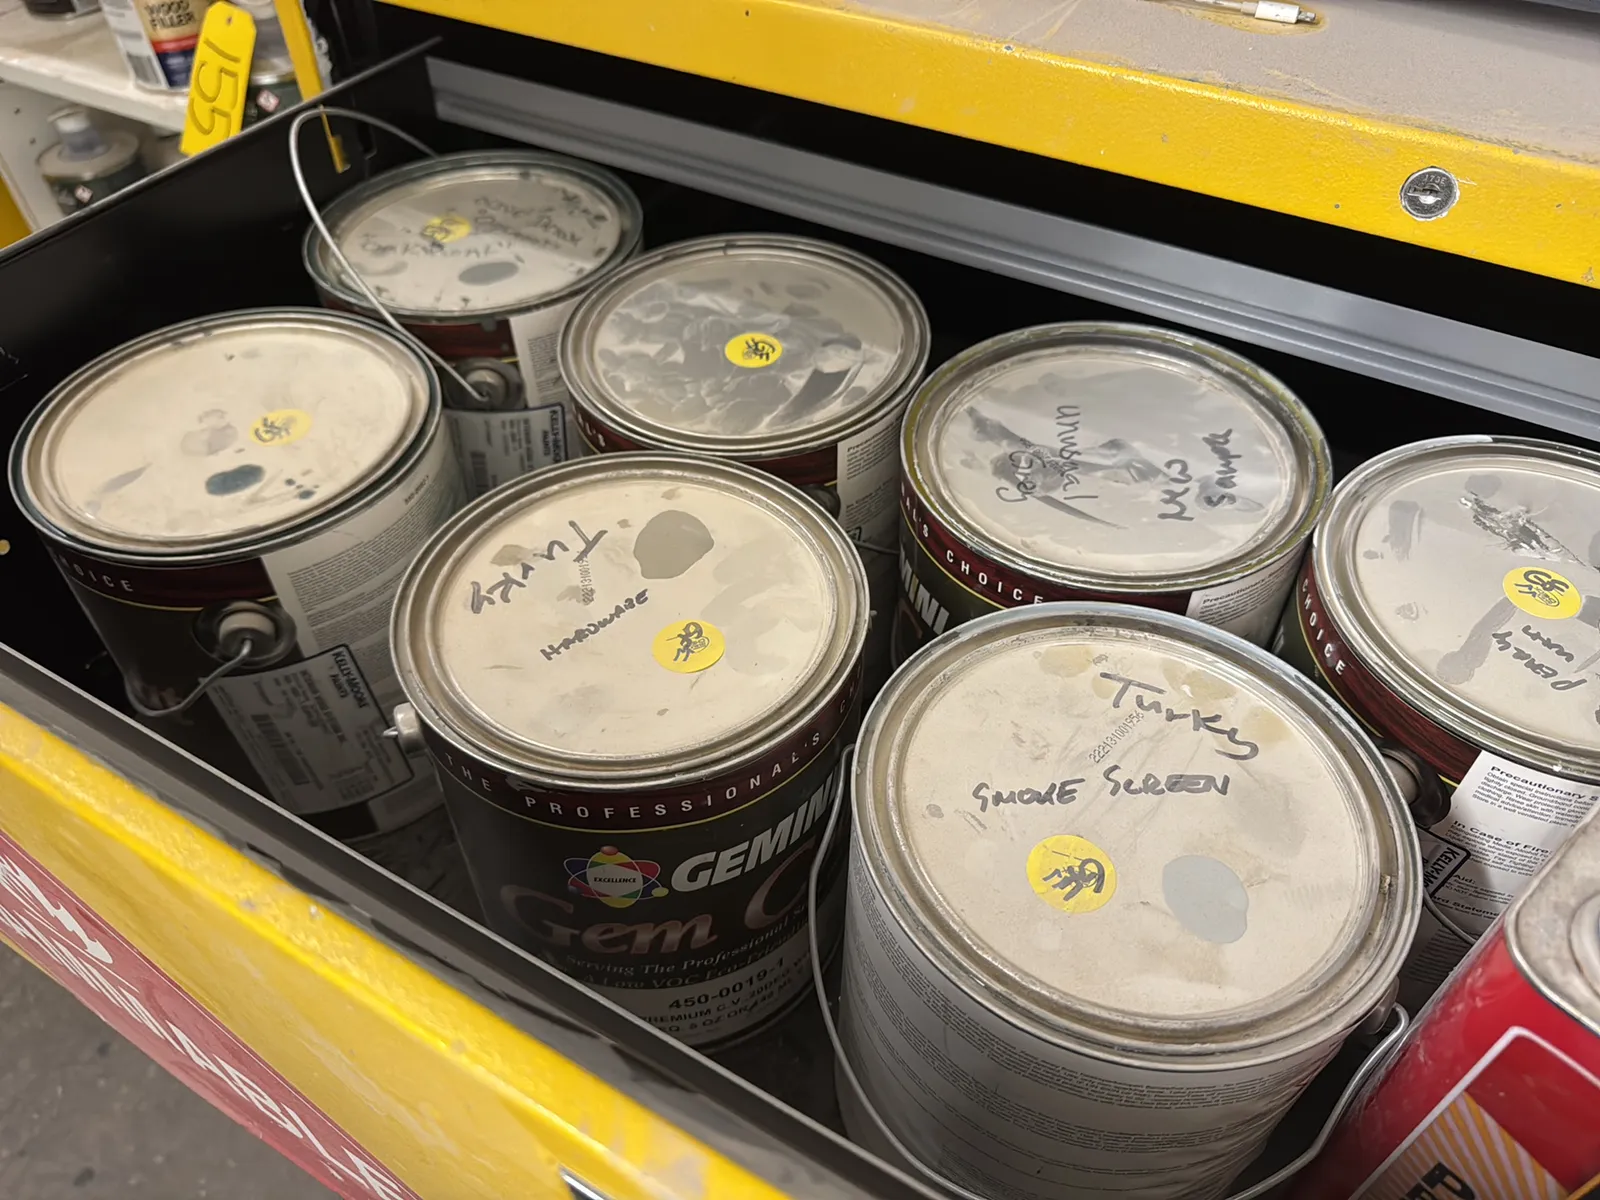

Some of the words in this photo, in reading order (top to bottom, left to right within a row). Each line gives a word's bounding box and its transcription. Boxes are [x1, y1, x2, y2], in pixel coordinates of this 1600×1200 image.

[151, 11, 195, 29] FILLER
[189, 38, 241, 139] 155
[995, 451, 1046, 502] Grey
[1055, 404, 1099, 500] unusual
[946, 550, 1044, 605] CHOICE
[1301, 578, 1346, 676] CHOICE
[444, 752, 493, 792] THE
[525, 731, 822, 820] PROFESSIONAL'S
[1103, 764, 1230, 797] SCREEN
[1491, 766, 1586, 799] Precautionary
[1454, 821, 1466, 829] In
[1470, 828, 1502, 842] Case
[1506, 839, 1522, 847] of
[500, 884, 719, 955] Gem
[566, 954, 635, 977] Serving
[641, 963, 675, 975] The
[684, 921, 788, 971] Professional
[652, 974, 699, 989] VOC
[669, 957, 786, 1010] 450-0019-1
[0, 904, 404, 1200] AMMABLE
